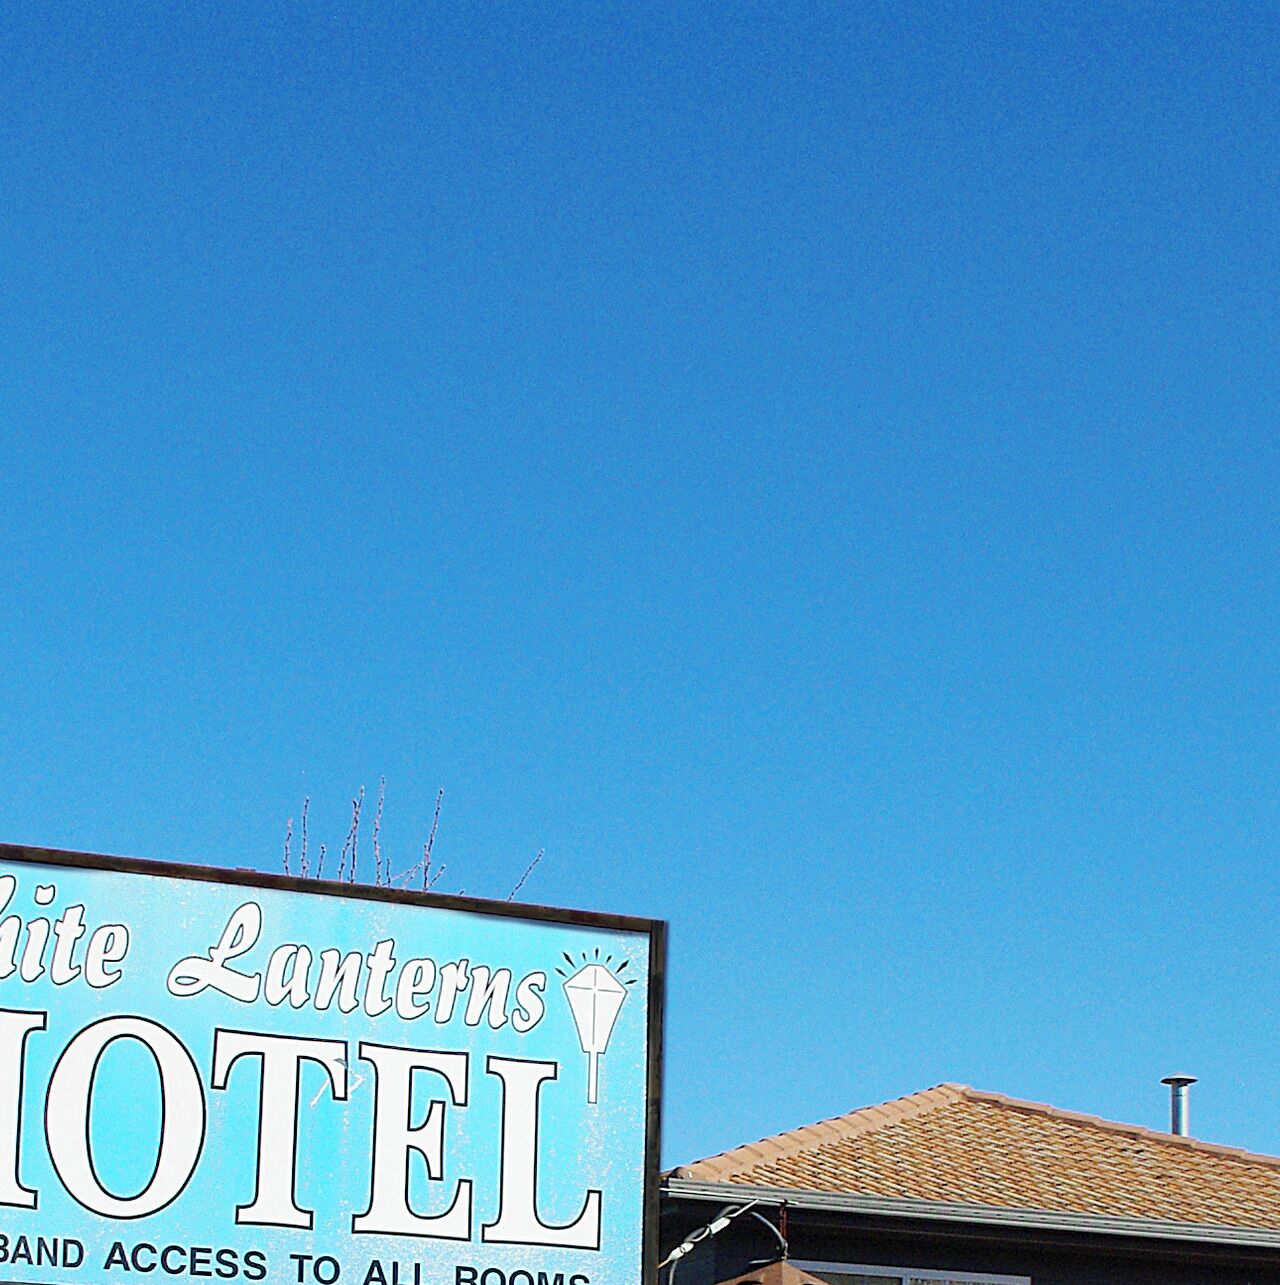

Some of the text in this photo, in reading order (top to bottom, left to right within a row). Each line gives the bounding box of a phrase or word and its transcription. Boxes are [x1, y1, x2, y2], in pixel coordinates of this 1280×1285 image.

[167, 900, 547, 1033] Lanterns
[103, 1241, 268, 1282] ACCESS
[289, 1254, 341, 1285] TO
